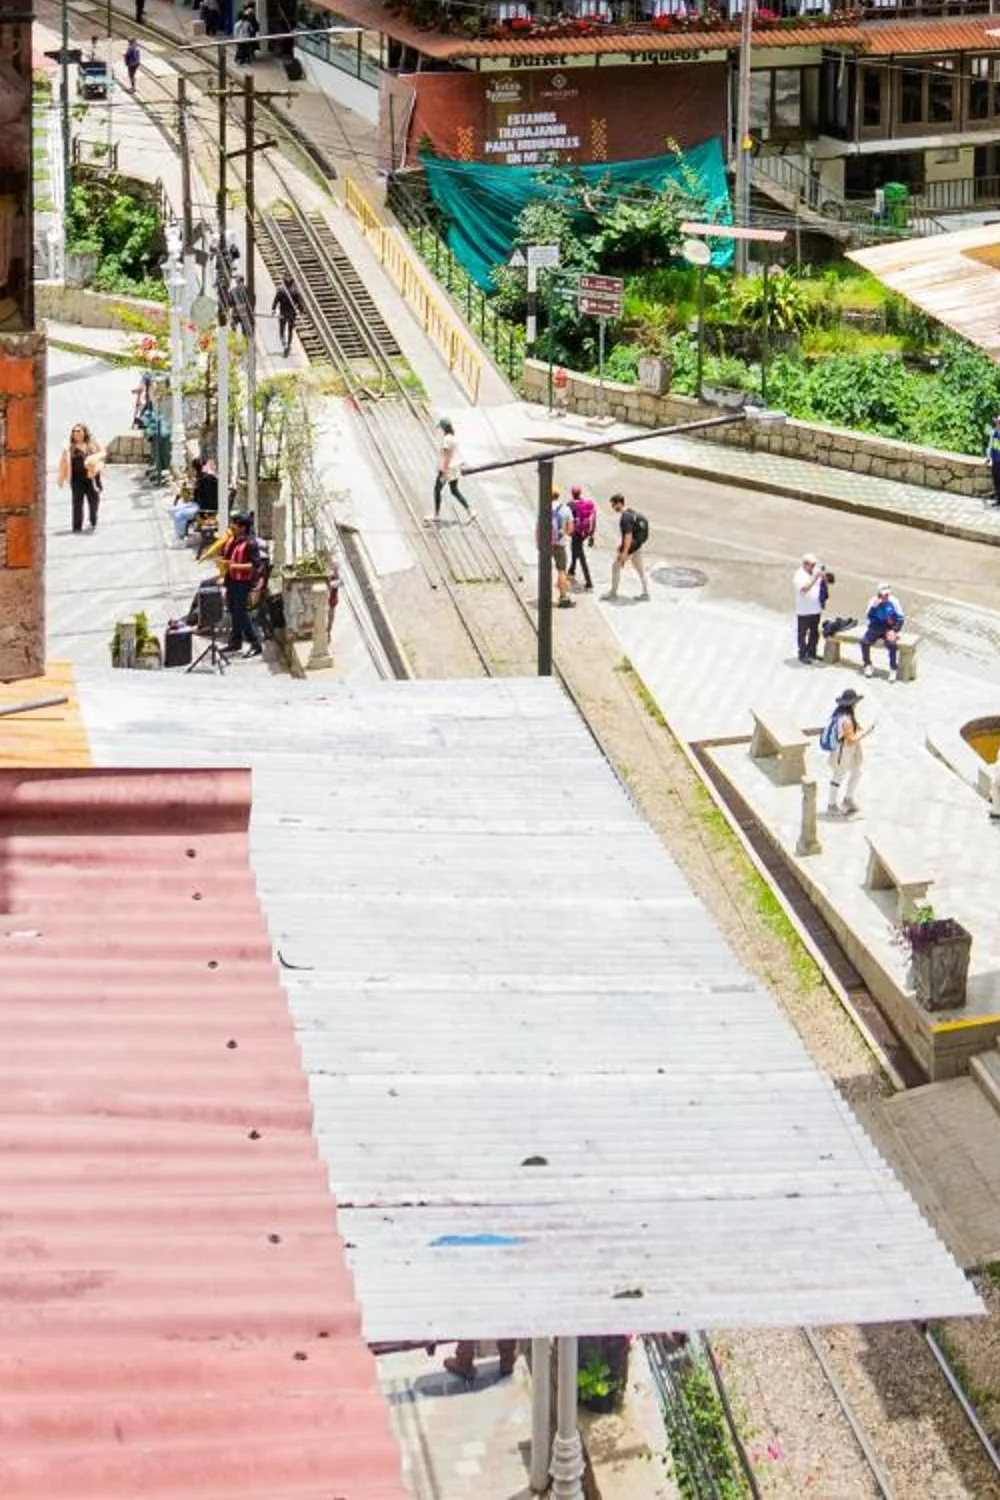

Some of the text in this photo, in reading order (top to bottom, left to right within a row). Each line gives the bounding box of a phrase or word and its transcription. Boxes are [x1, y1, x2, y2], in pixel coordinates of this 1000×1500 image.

[507, 112, 557, 125] ESTAMOS
[499, 124, 567, 138] TRABAJANDO
[485, 140, 514, 153] PARA
